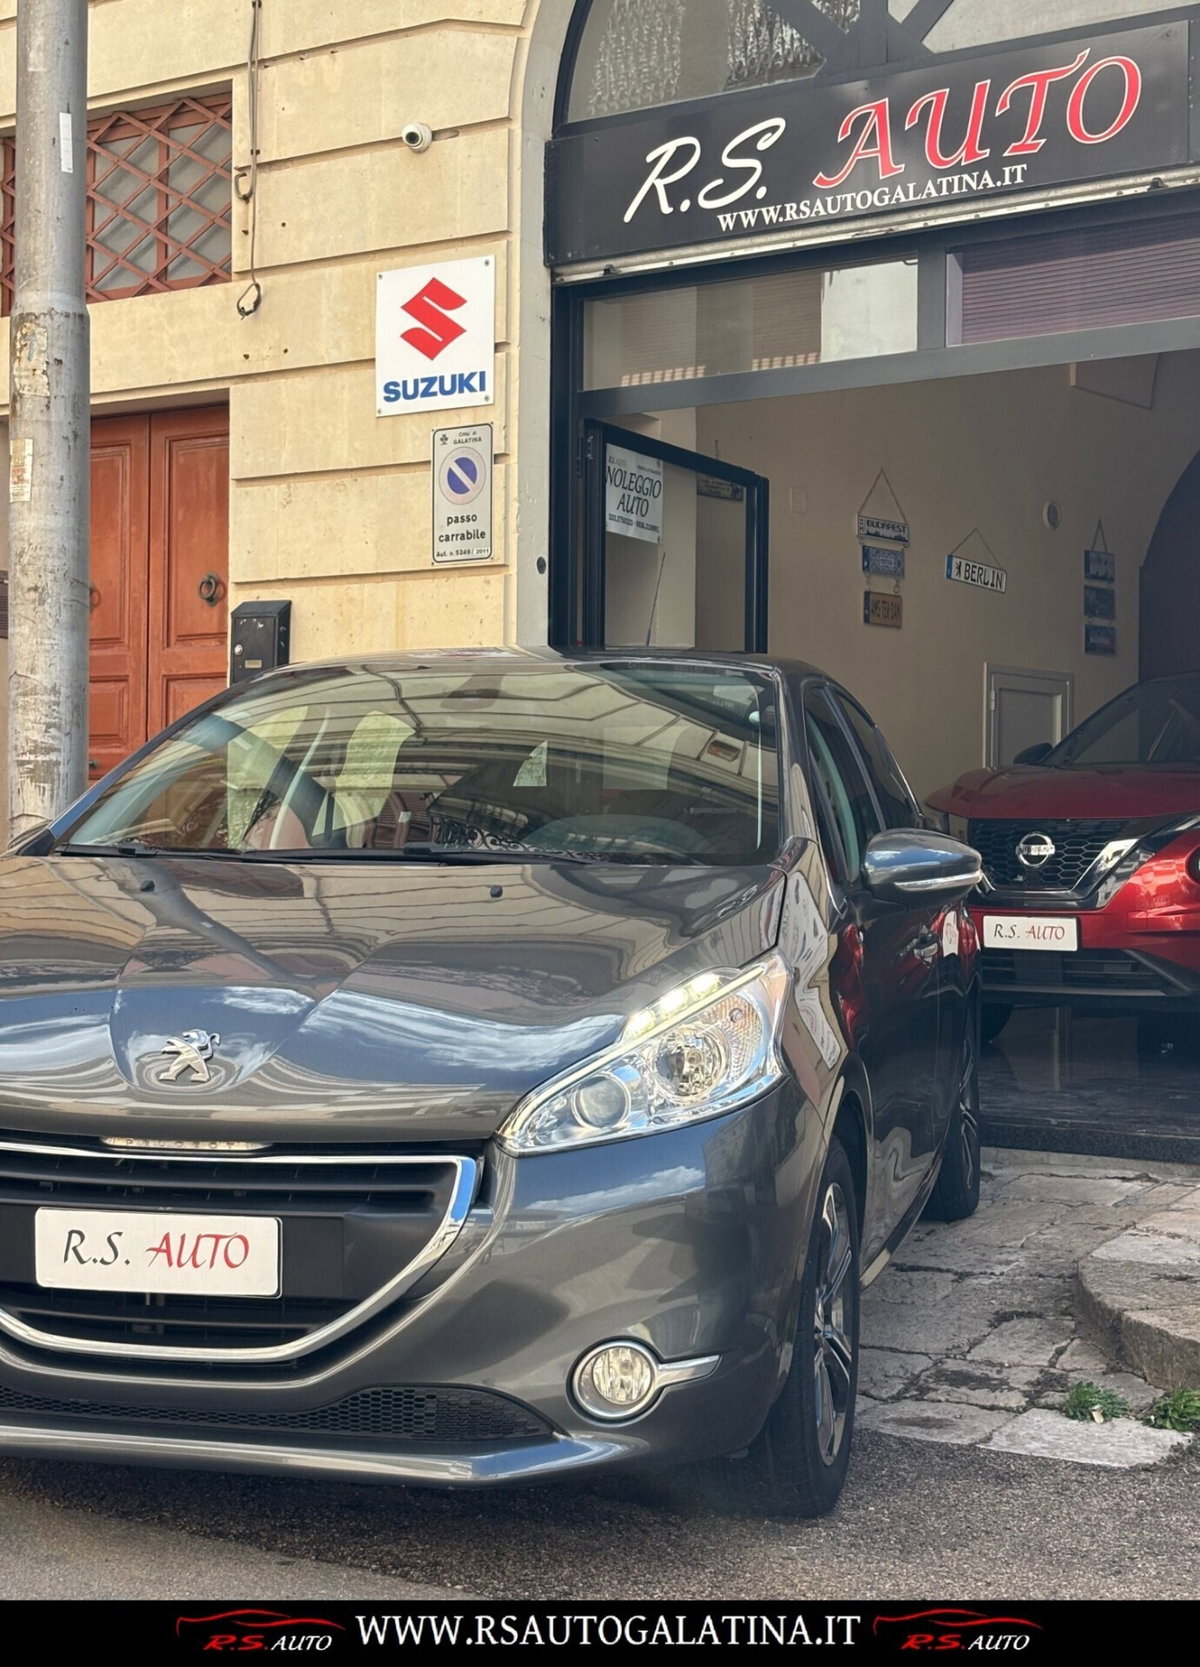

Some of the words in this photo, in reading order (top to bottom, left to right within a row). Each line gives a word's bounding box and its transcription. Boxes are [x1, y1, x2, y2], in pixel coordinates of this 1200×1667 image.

[624, 116, 786, 223] R.S.
[812, 47, 1143, 189] AUTO
[717, 164, 1027, 232] WWW.RSAUTOGALATINA.IT
[383, 370, 486, 403] SUZUKI
[453, 436, 482, 445] GALATINA
[605, 465, 662, 499] NOLEGGIO
[616, 492, 650, 517] AUTO
[446, 514, 478, 527] passo
[866, 519, 907, 534] BUDAPEST
[438, 528, 486, 543] carrabile
[963, 562, 1003, 591] BERLIN
[993, 923, 1021, 939] R.S.
[1025, 925, 1066, 940] AUTO
[63, 1229, 130, 1266] R.S.
[145, 1231, 250, 1270] AUTO
